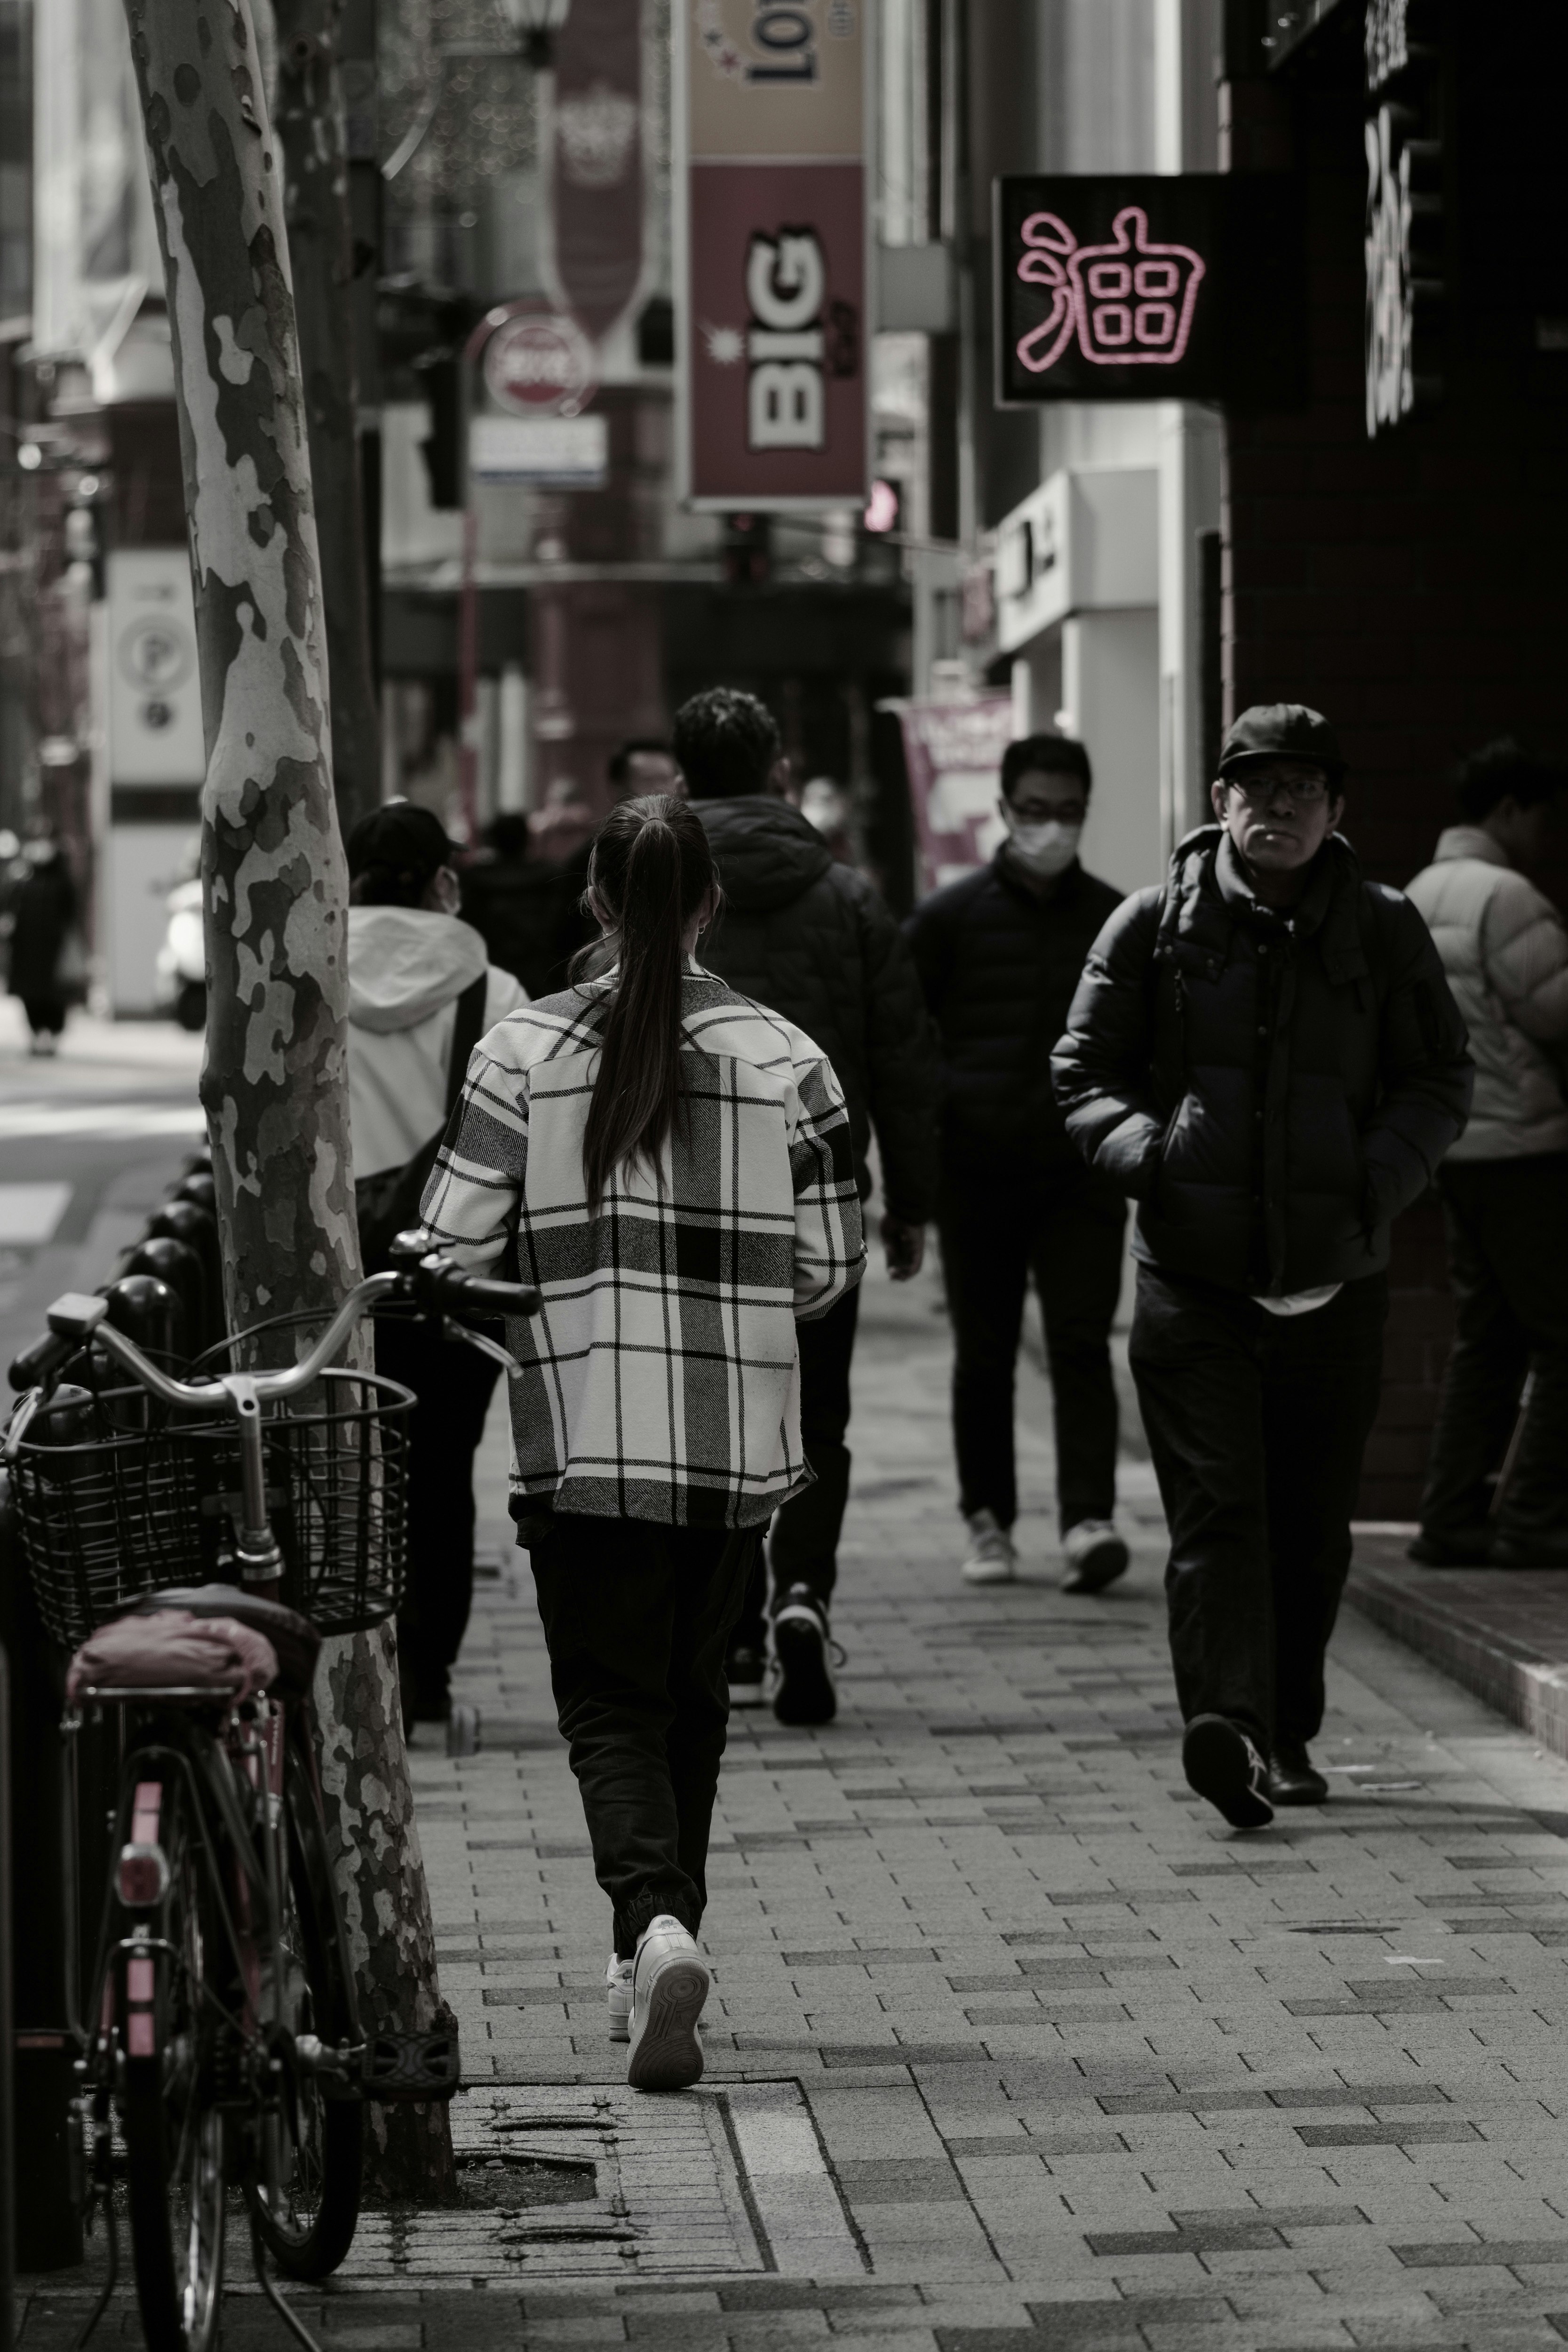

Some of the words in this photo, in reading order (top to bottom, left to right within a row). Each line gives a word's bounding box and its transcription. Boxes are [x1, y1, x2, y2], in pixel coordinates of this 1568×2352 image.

[748, 0, 813, 80] LO
[745, 226, 827, 452] BIG
[1017, 206, 1206, 373] 油
